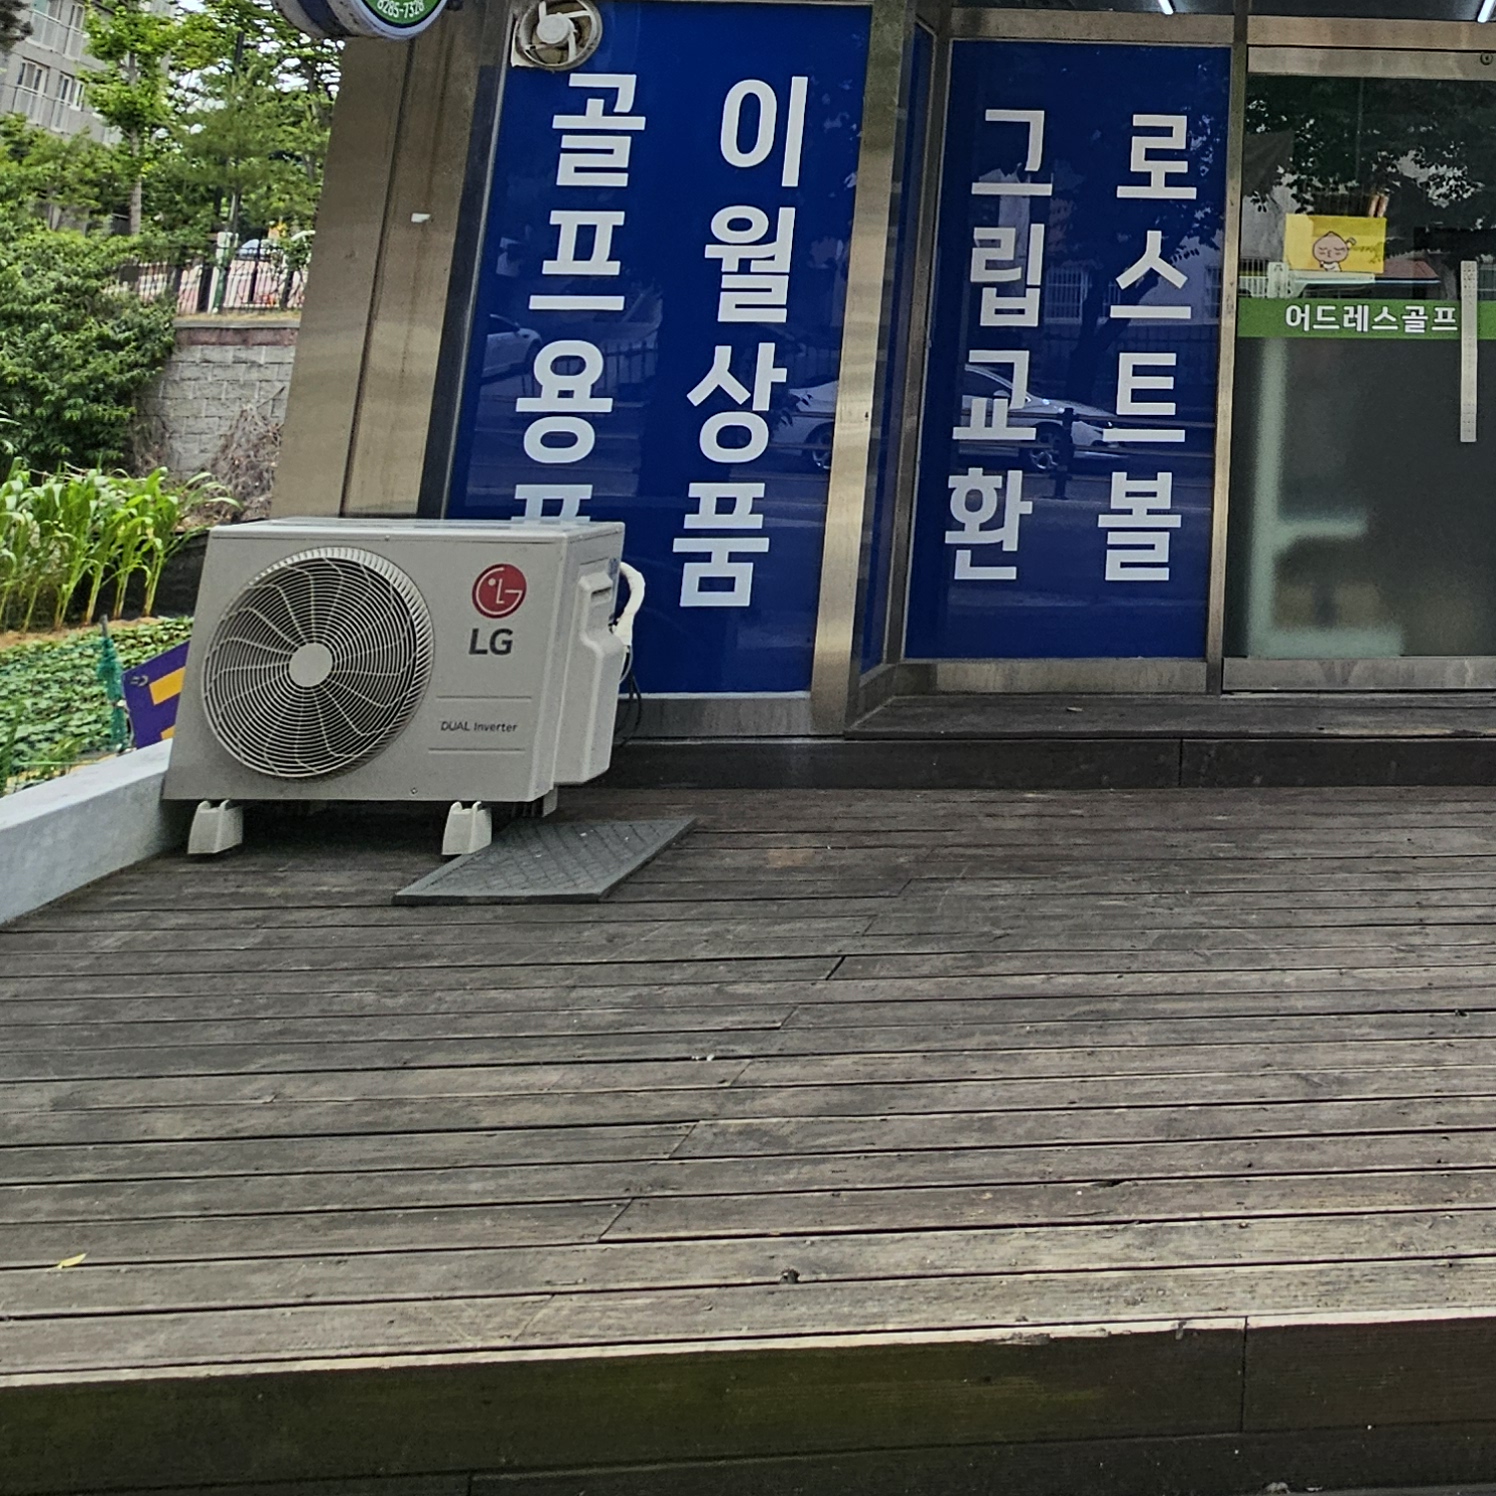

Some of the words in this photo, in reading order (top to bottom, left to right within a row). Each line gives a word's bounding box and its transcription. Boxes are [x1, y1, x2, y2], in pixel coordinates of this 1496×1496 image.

[672, 75, 809, 609] 이월상품
[944, 108, 1053, 581] 그립교환
[1097, 113, 1197, 582] 로스트볼
[1285, 303, 1459, 334] 어드레스골프
[440, 720, 471, 732] DUAL
[474, 721, 518, 733] Inverter
[468, 627, 514, 656] LG
